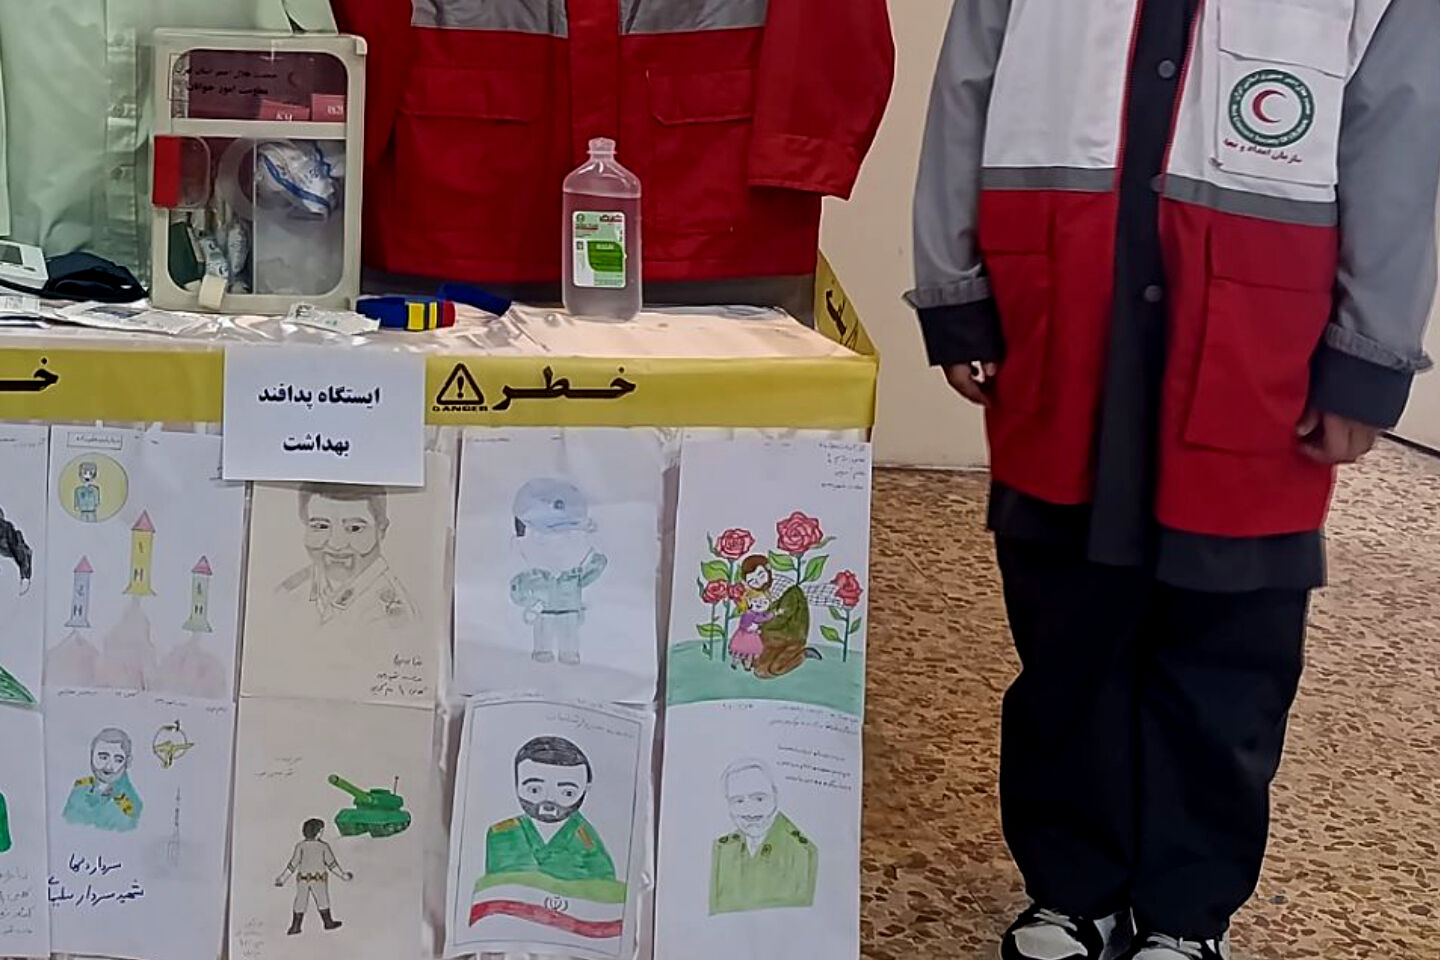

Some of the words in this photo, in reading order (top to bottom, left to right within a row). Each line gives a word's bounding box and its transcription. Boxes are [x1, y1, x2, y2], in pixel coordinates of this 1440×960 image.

[258, 383, 313, 410] پدافند
[318, 384, 381, 408] ایستگاه
[492, 363, 637, 411] خطر
[283, 434, 351, 457] بهداشت
[89, 855, 121, 875] سردار
[76, 885, 115, 906] سردار
[116, 879, 144, 903] شهید
